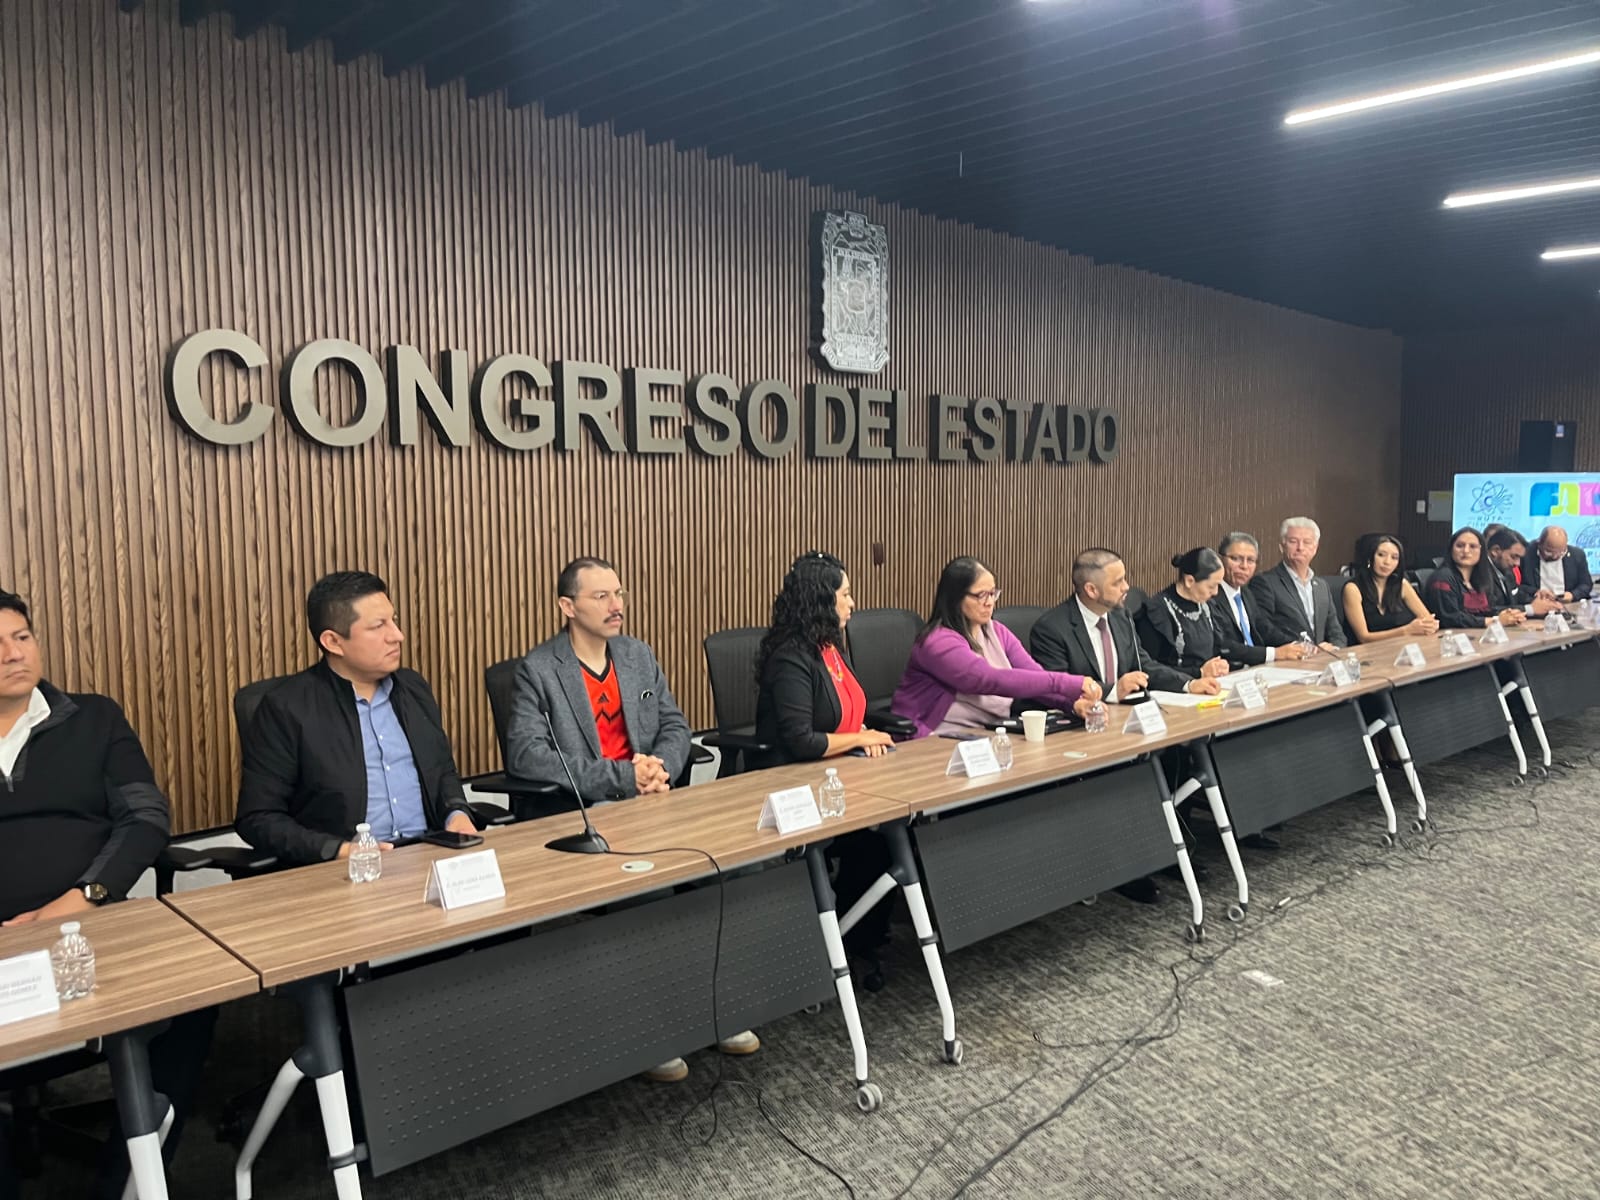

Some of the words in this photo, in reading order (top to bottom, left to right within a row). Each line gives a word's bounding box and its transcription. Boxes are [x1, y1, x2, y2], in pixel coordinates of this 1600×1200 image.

[168, 328, 798, 458] CONGRESO
[811, 382, 927, 460] DEL
[935, 394, 1121, 463] ESTADO
